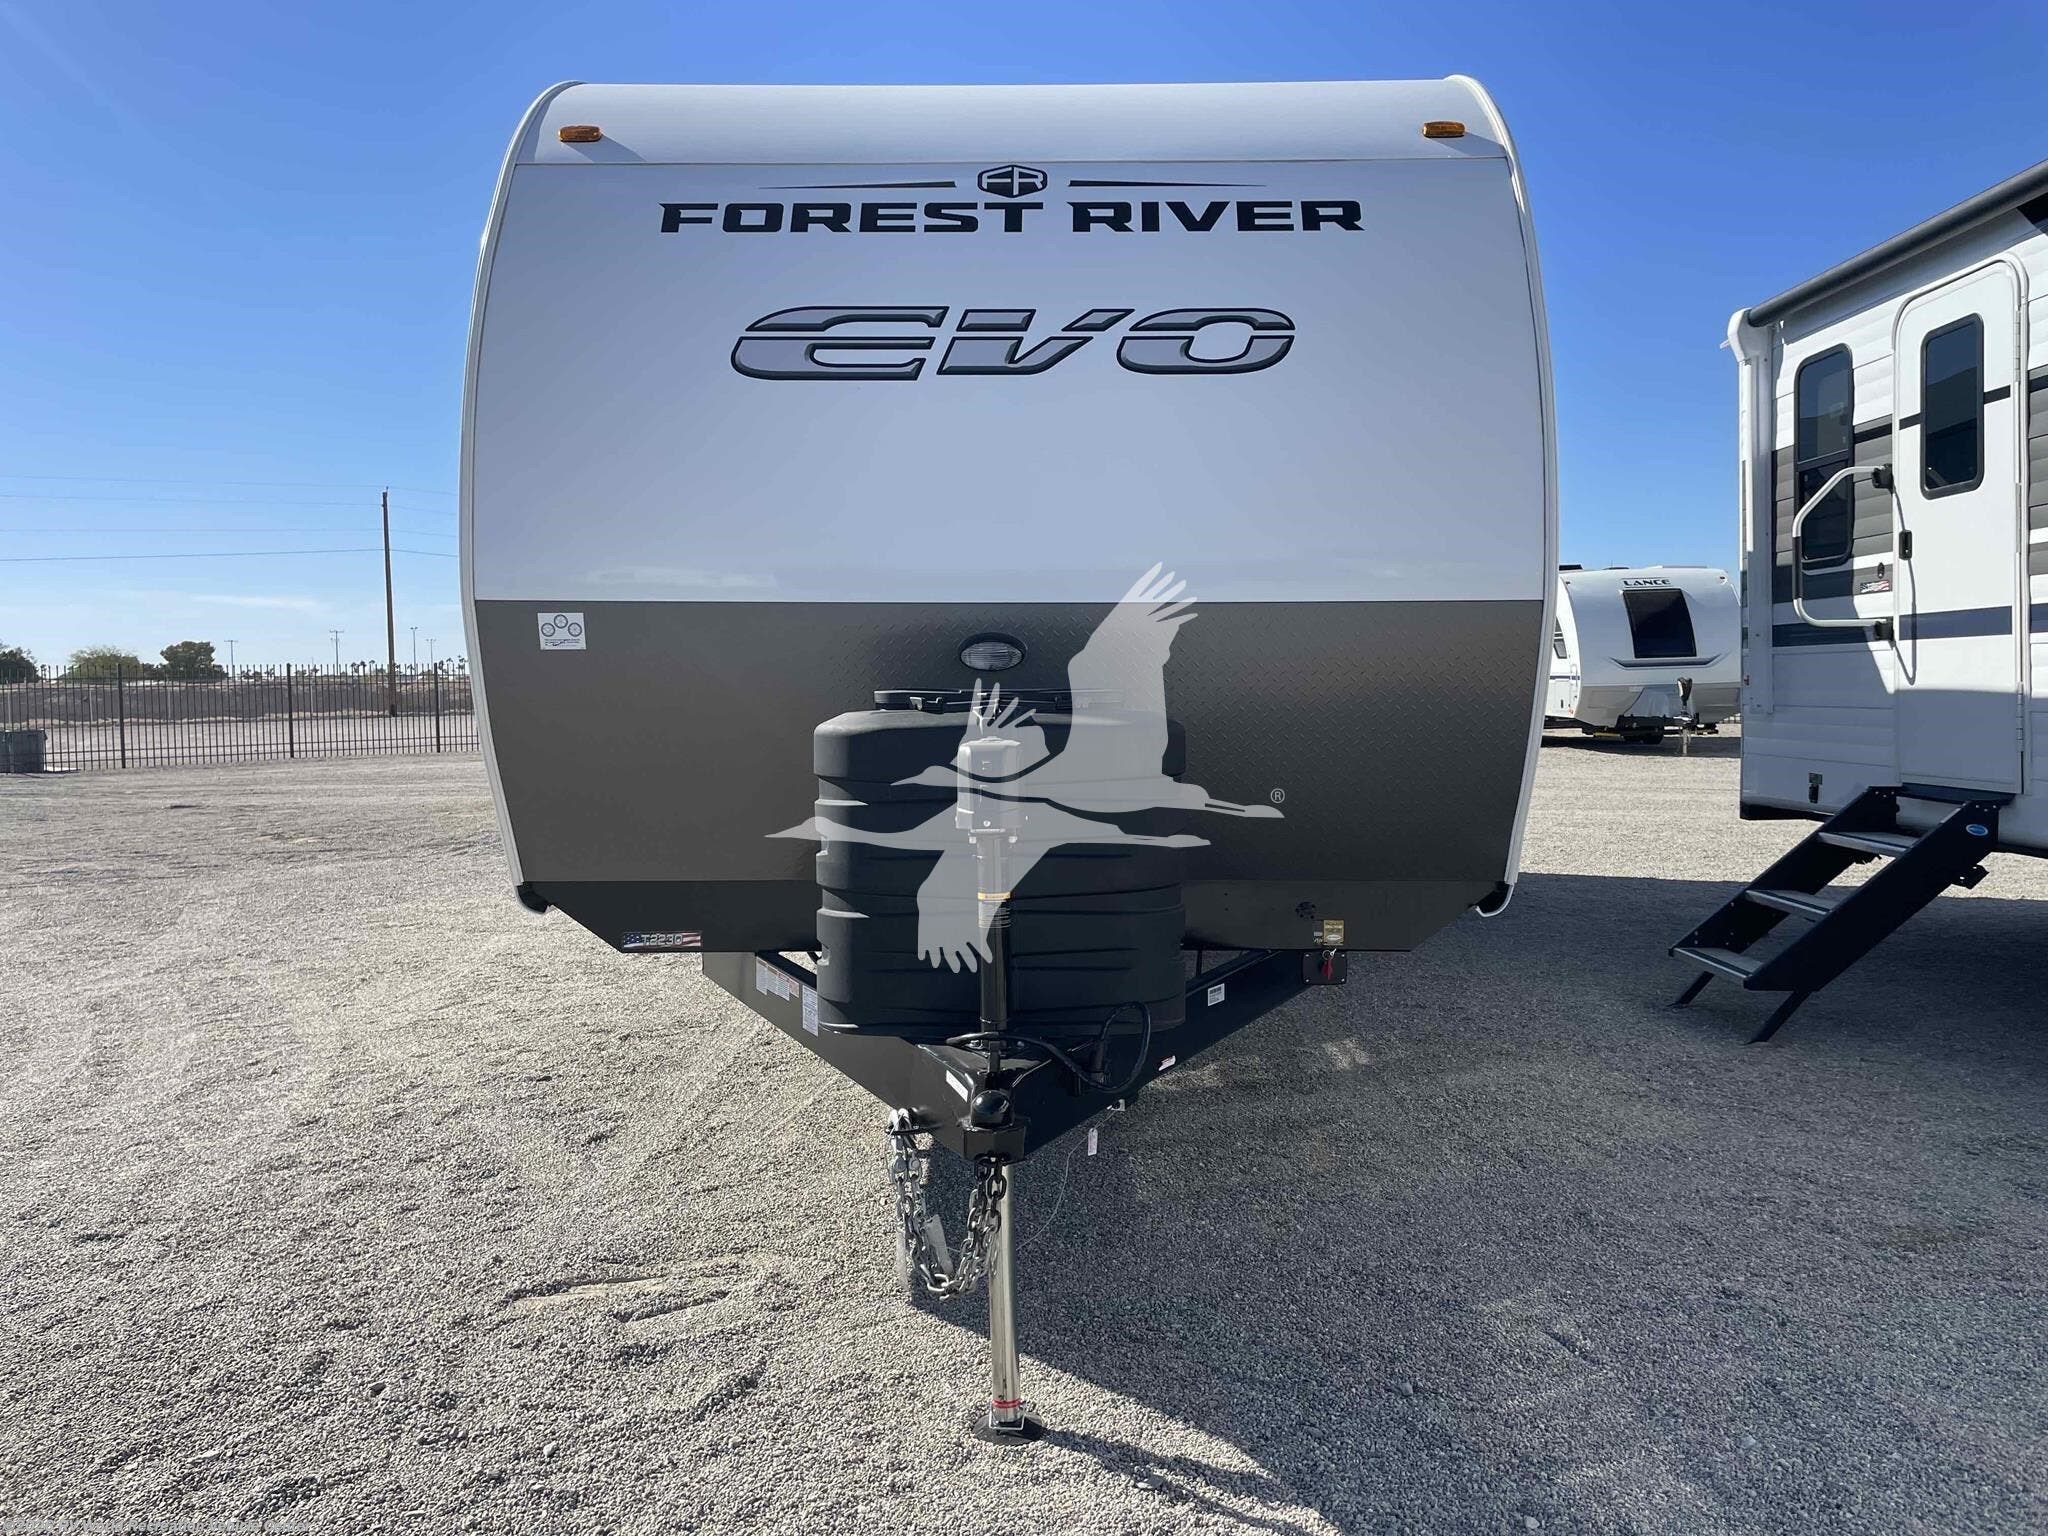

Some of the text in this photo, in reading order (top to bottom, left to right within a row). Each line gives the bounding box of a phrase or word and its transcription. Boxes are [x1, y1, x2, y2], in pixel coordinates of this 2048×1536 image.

[658, 199, 1366, 233] FOREST RIVER
[730, 305, 1296, 381] EVO
